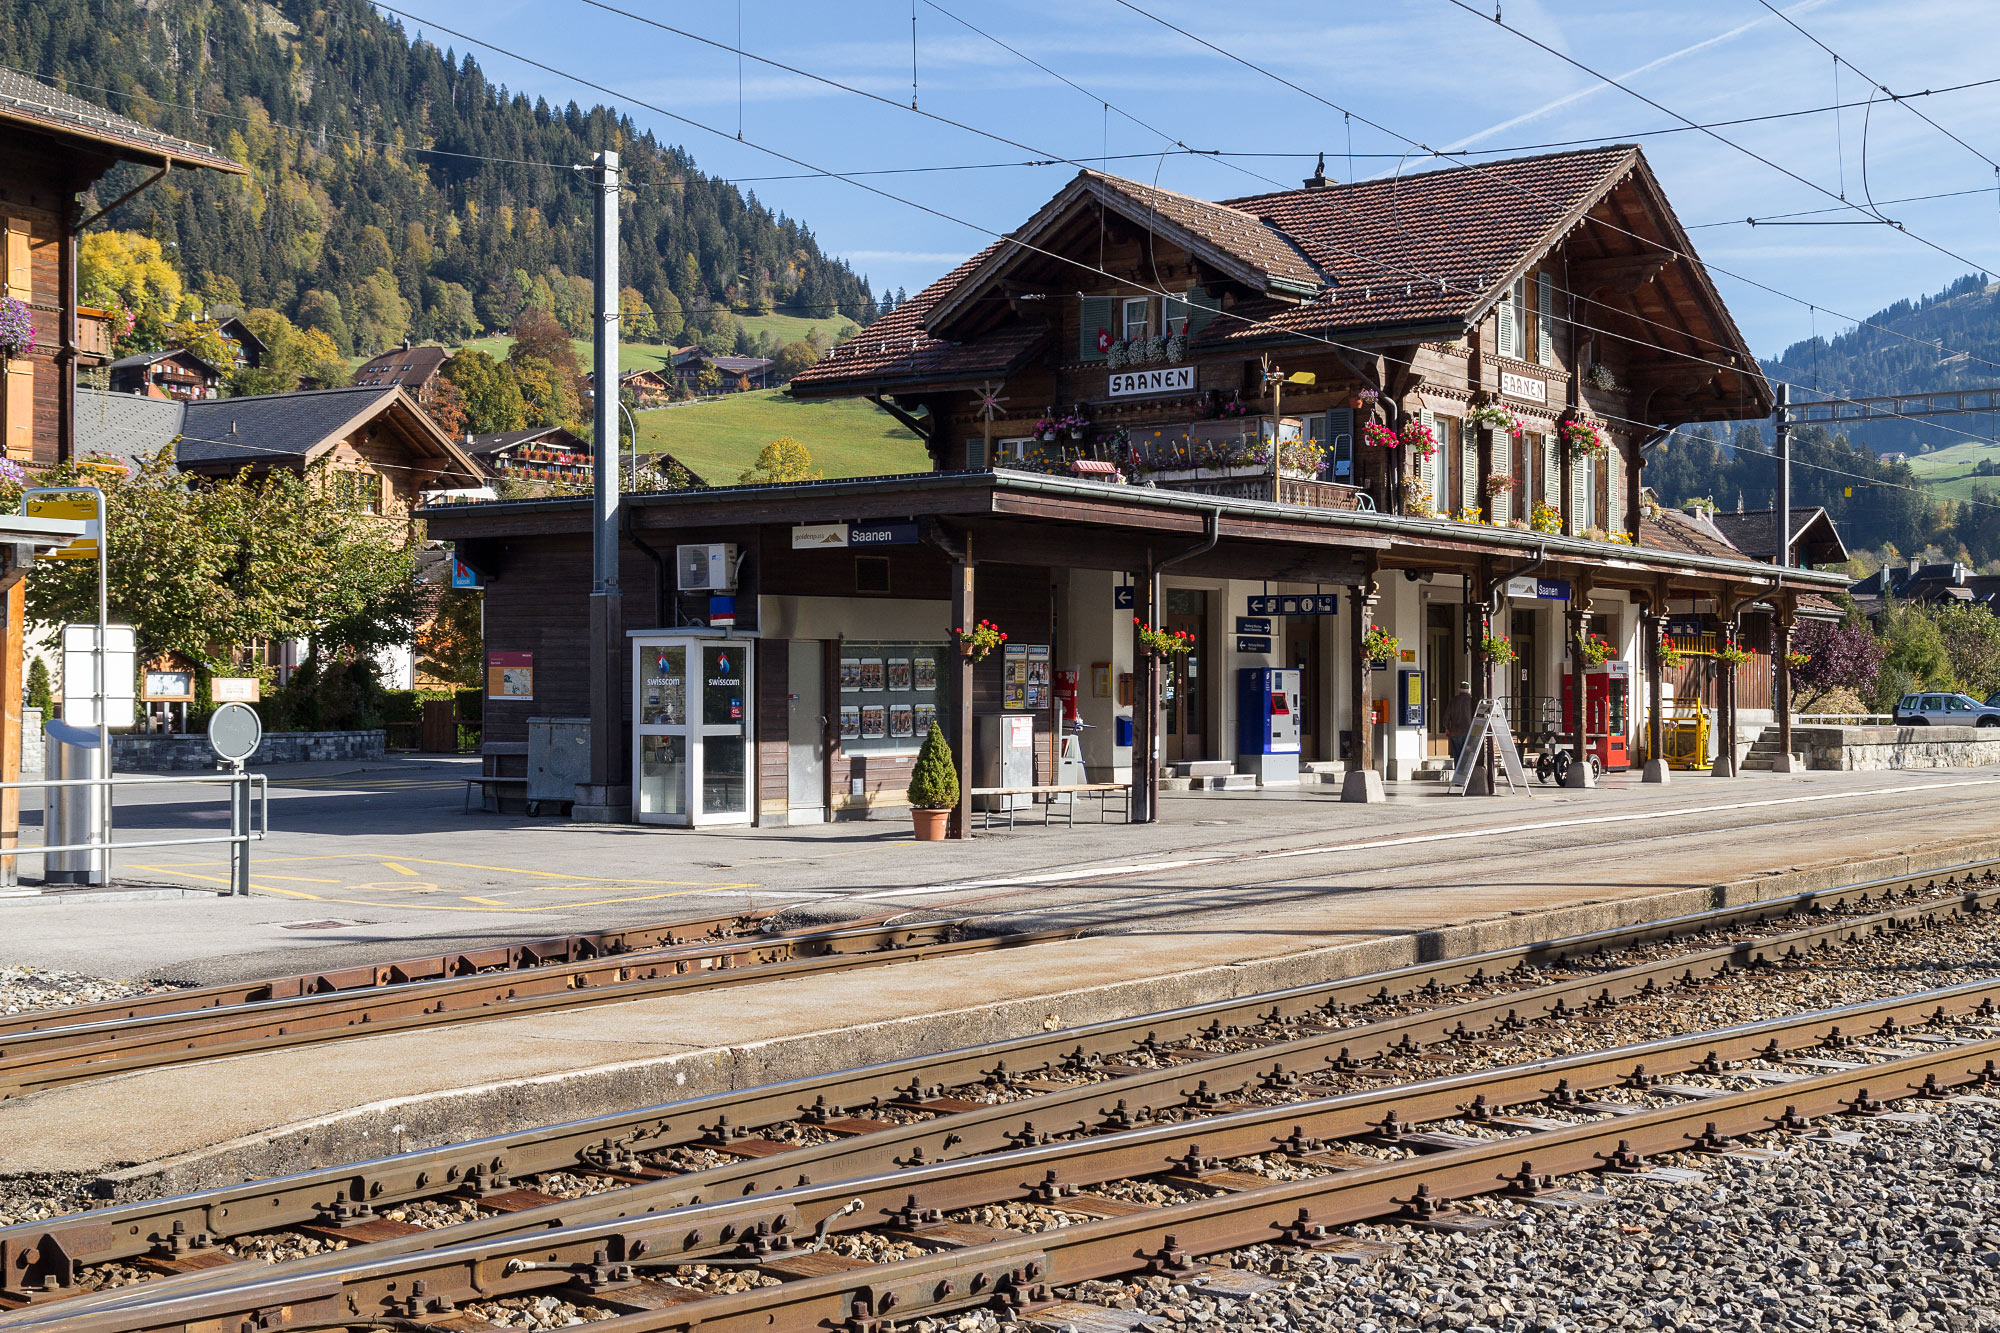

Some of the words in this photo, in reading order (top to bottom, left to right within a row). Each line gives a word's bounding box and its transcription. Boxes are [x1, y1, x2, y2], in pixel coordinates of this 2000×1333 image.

[1112, 370, 1189, 392] SAANEN
[1503, 375, 1543, 398] SAANEN
[851, 530, 892, 542] Saanen
[1538, 584, 1559, 596] Saanen
[647, 677, 680, 686] swisscom
[708, 677, 740, 686] swisscom
